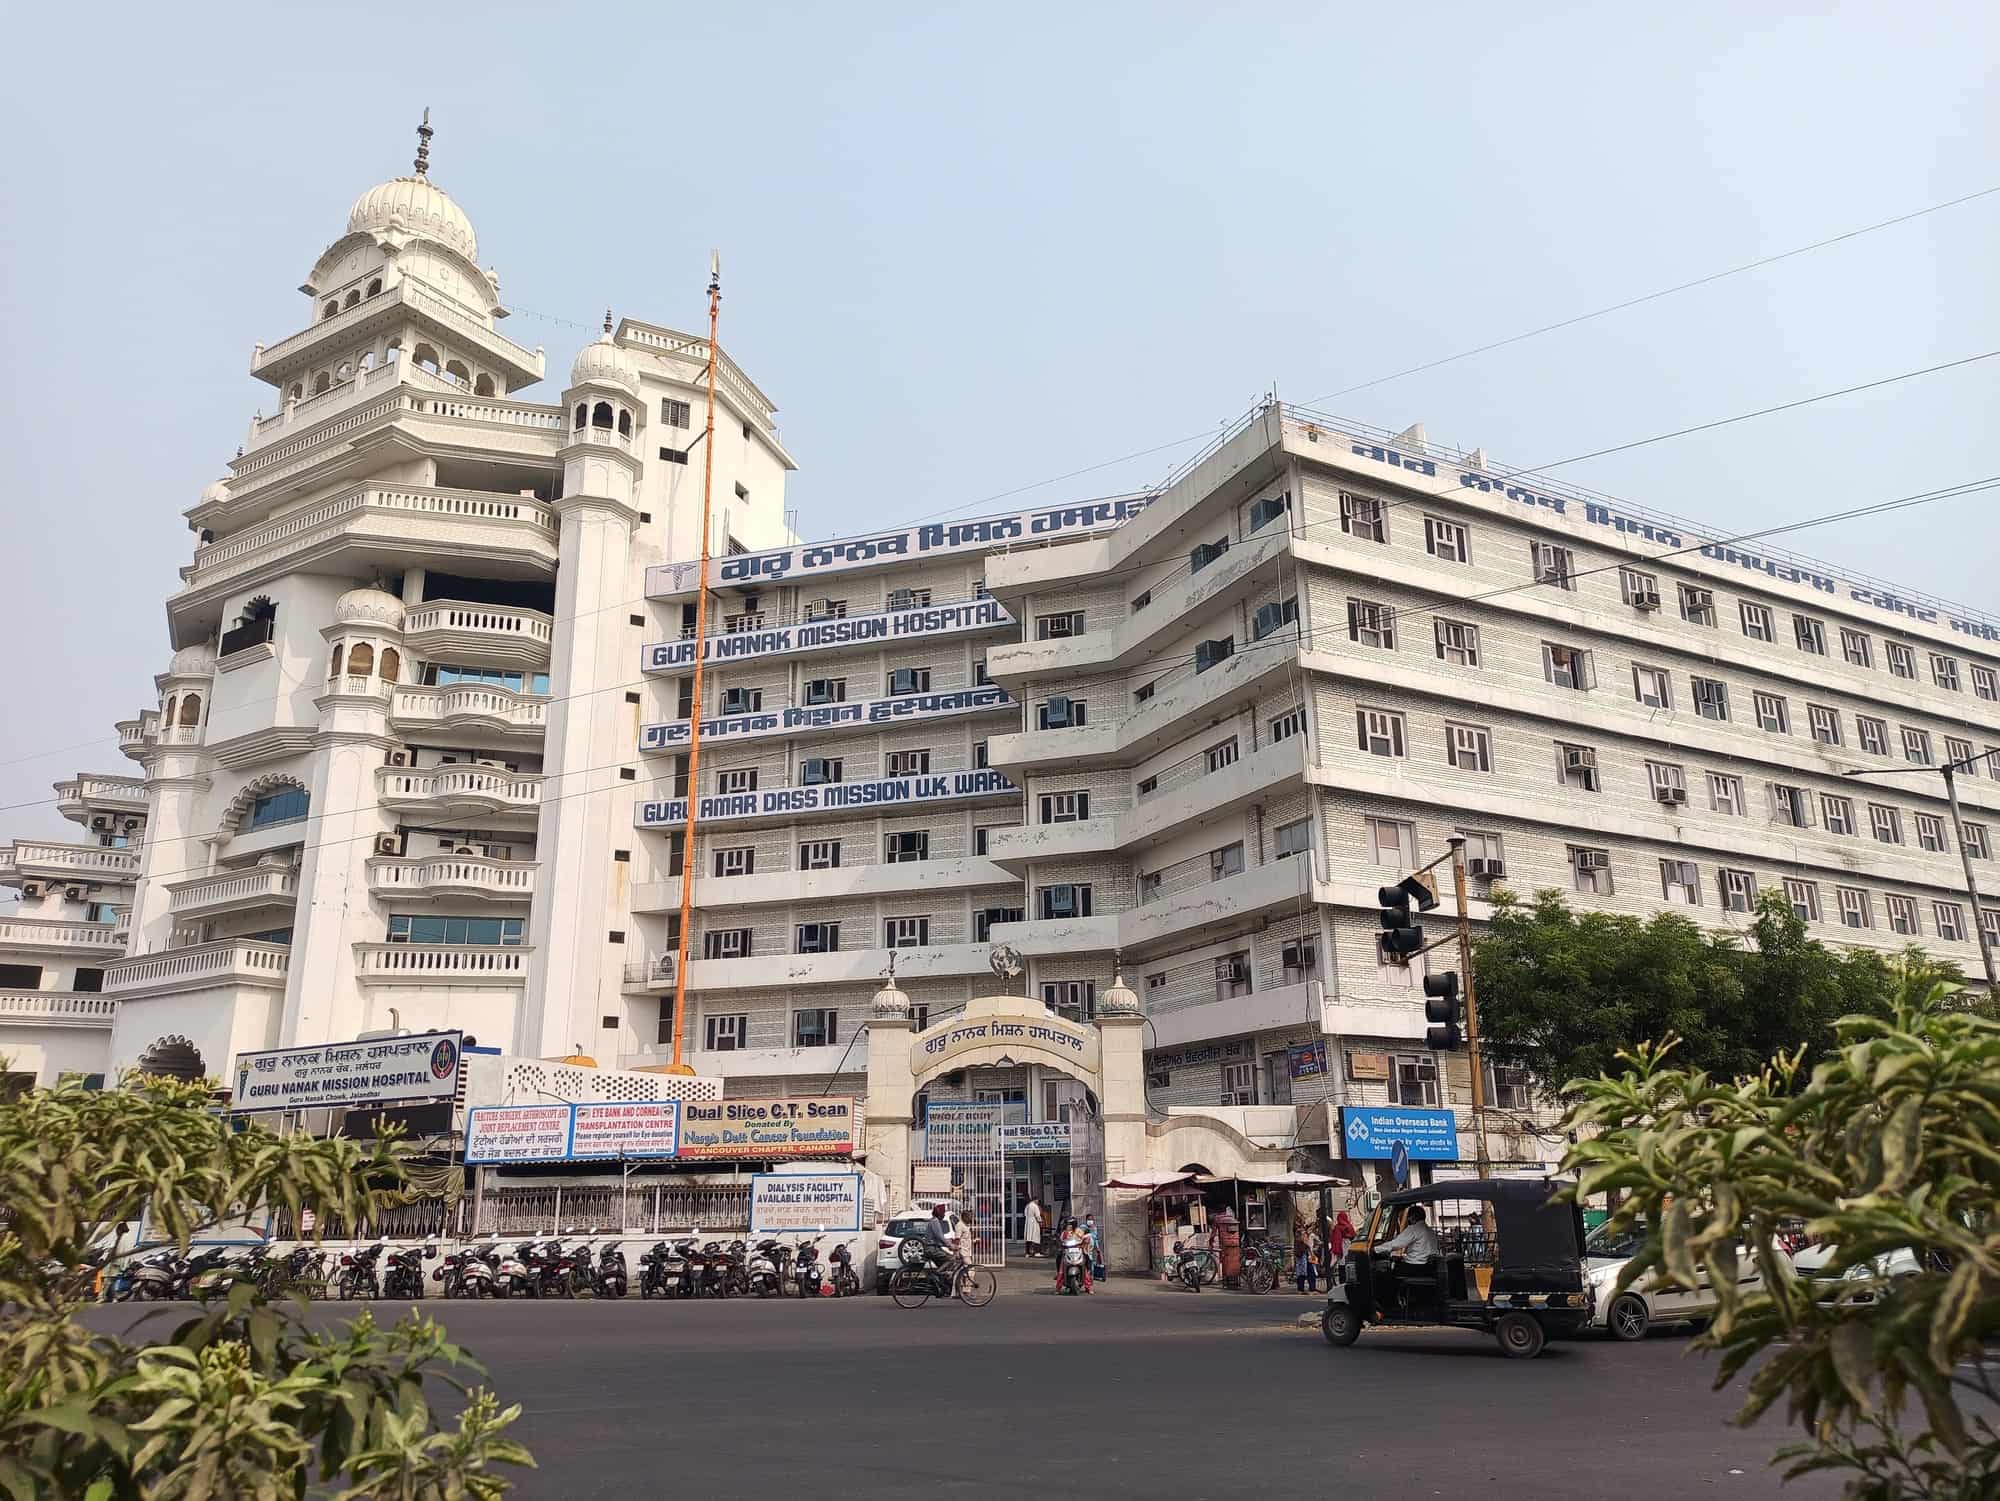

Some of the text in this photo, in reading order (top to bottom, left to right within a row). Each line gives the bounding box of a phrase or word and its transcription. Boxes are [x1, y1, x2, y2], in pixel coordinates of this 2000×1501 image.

[802, 533, 910, 569] ਨਾਨਕ
[918, 516, 1022, 551] ਮਿਸ਼ਨ
[653, 602, 1007, 666] GURU NANAK MISSION HOSPITAL
[698, 713, 779, 737] नानक
[783, 703, 863, 728] मिशन
[700, 794, 757, 818] AMAR
[763, 789, 819, 812] DASS
[823, 780, 910, 807] MISSION
[915, 777, 950, 798] U.K.
[951, 1025, 988, 1043] ਨਾਨਕ
[991, 1020, 1025, 1037] ਮਿਸ਼ਨ
[1028, 1025, 1084, 1052] ਹਸਪਤਾਲ
[281, 1053, 322, 1067] ਨਾਨਕ
[367, 1041, 432, 1059] ਹਸਪਤਾਲ
[310, 1066, 334, 1076] ਨਾਨਕ
[249, 1071, 431, 1097] GURU NANAK MISSION HOSPITAL
[592, 1108, 604, 1118] EYE
[606, 1107, 621, 1118] BANK
[623, 1107, 635, 1117] AND
[686, 1102, 849, 1120] Dual Slice C.T. Scan
[576, 1119, 673, 1130] TRANSPLANTATION CENTRE
[744, 1119, 795, 1129] Donated By
[1371, 1116, 1448, 1128] Indian Overseas Bank
[790, 1127, 850, 1142] Foundation
[1020, 1126, 1042, 1137] Slice
[694, 1147, 750, 1155] VANCOUVER
[799, 1144, 836, 1152] CANADA
[767, 1182, 844, 1193] DIALYSIS FACILITY
[757, 1192, 853, 1203] AVAILABLE IN HOSPITAL
